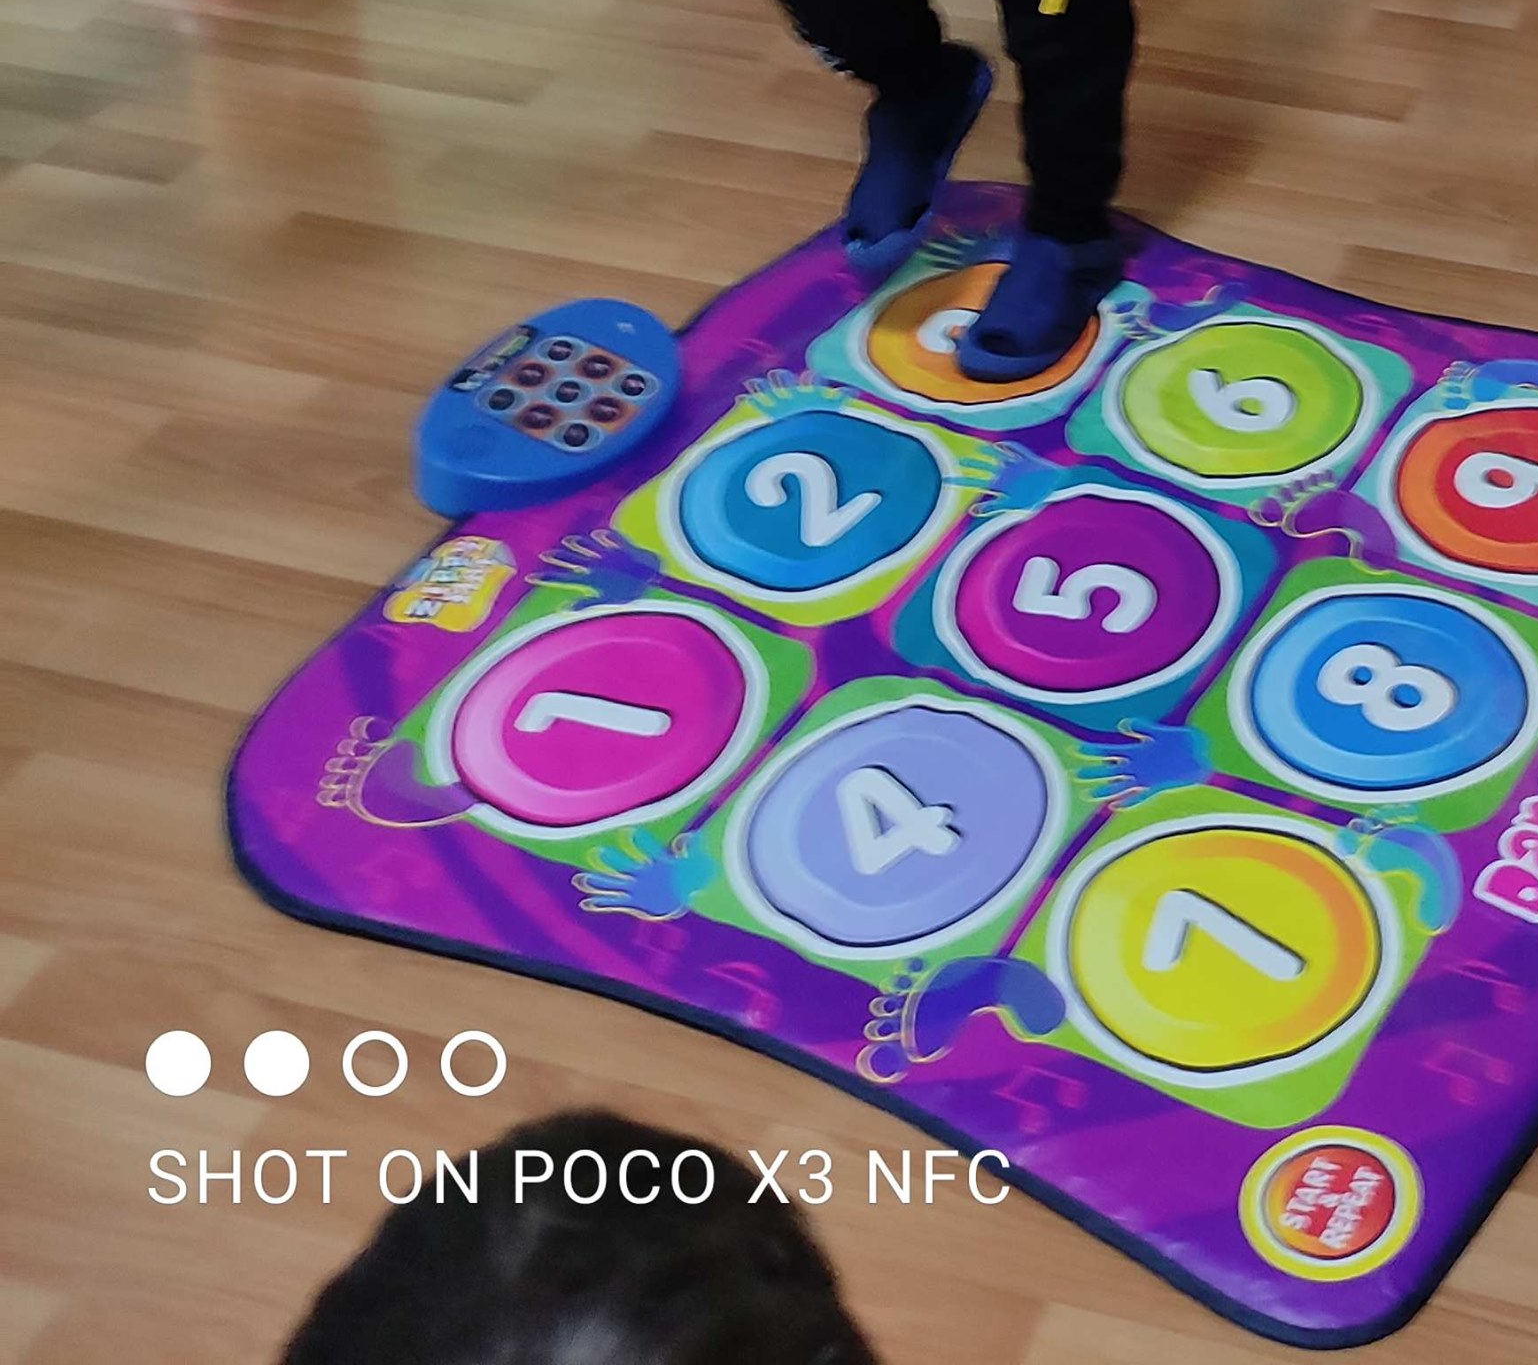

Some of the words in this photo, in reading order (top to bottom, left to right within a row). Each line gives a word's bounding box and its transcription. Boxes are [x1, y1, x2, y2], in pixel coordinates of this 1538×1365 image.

[1198, 366, 1298, 433] 6
[744, 450, 884, 547] 2
[1012, 553, 1161, 635] 5
[514, 690, 673, 737] 1
[1315, 641, 1457, 733] 8
[836, 765, 962, 877] 4
[1140, 887, 1307, 982] 7
[1279, 1156, 1343, 1230] START
[1318, 1165, 1385, 1250] REPEAT
